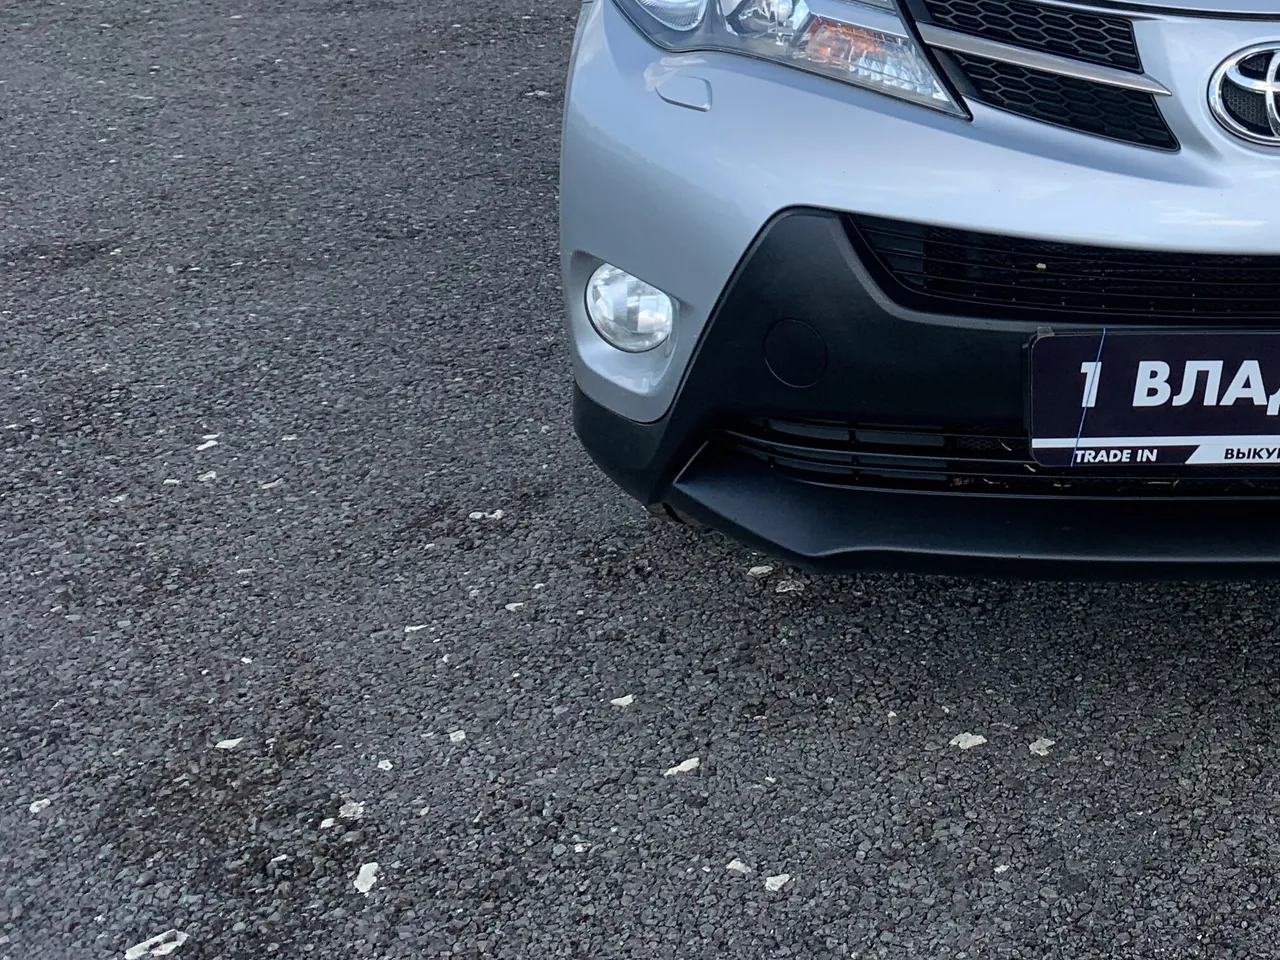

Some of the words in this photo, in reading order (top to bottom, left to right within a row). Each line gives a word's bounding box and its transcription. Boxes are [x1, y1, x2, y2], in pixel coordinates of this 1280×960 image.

[1080, 361, 1102, 408] 1
[1075, 449, 1132, 463] TRADE
[1136, 448, 1158, 463] IN
